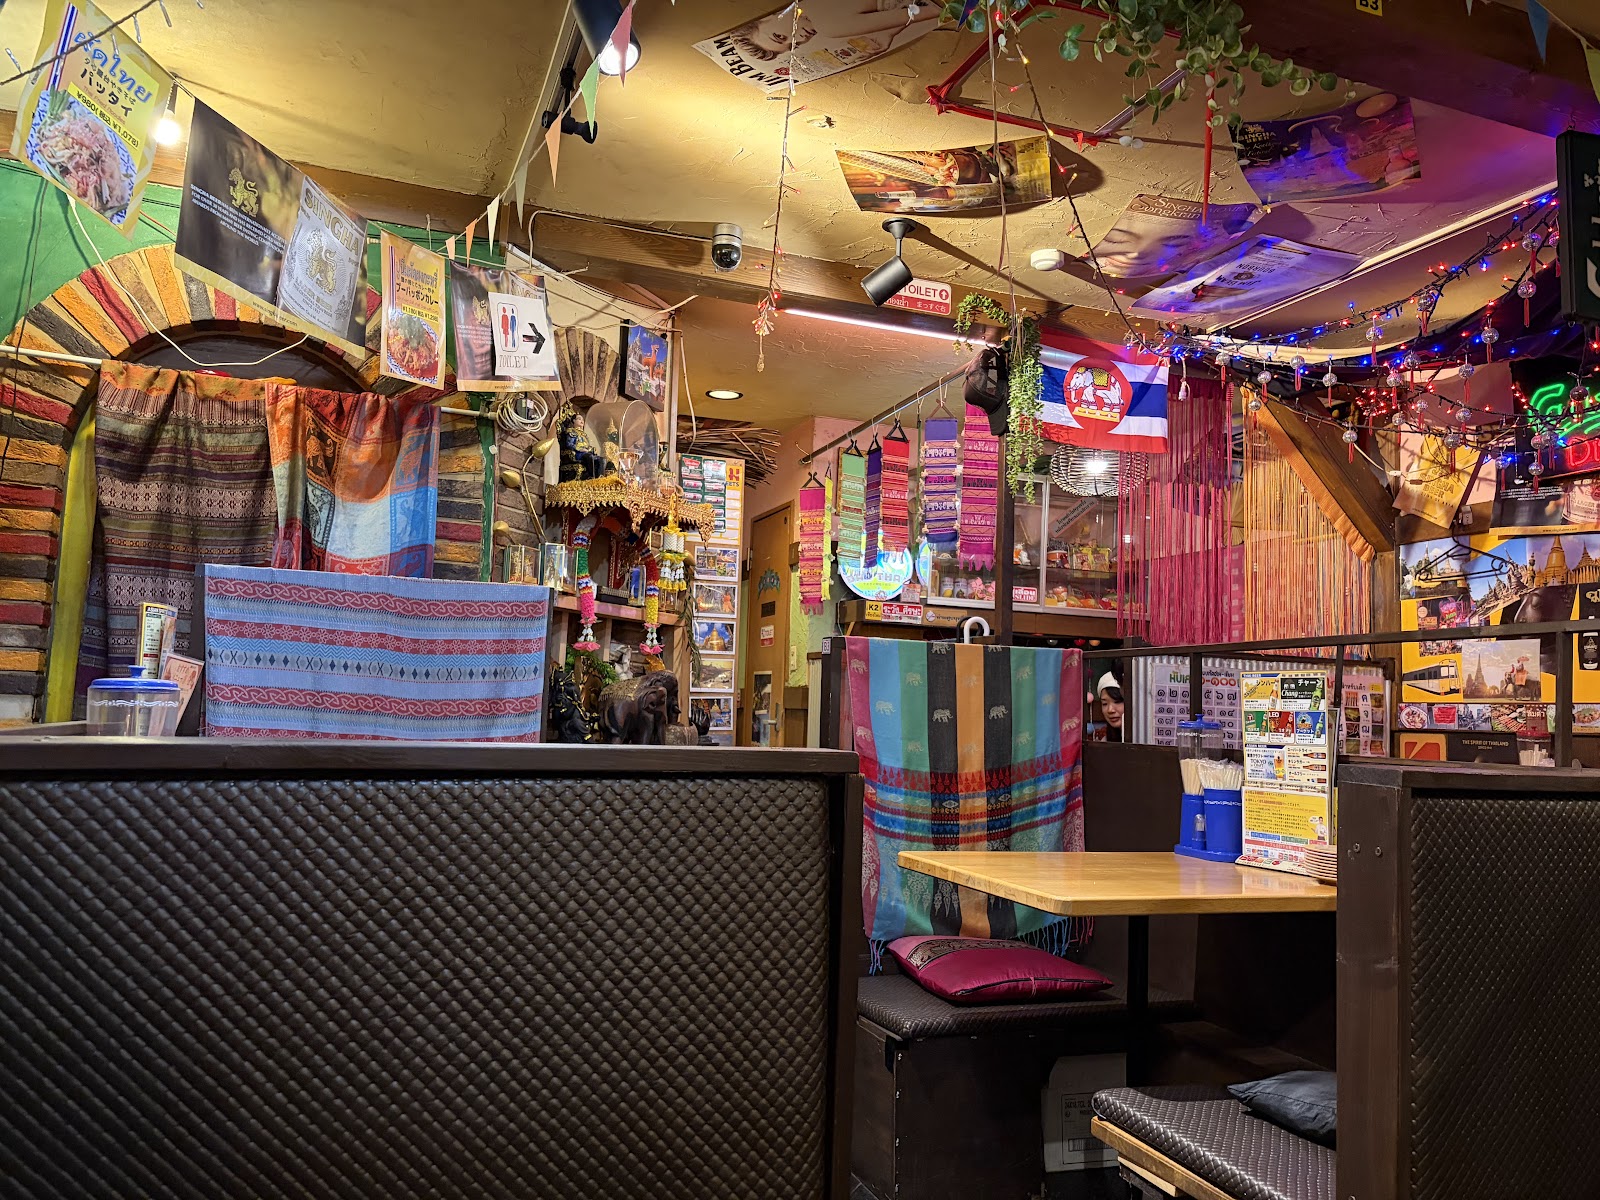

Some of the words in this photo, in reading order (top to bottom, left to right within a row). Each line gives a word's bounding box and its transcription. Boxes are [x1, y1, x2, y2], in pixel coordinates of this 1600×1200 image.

[714, 36, 754, 77] BEAM
[80, 68, 132, 118] パッタイ
[1155, 198, 1203, 214] SINGHA
[304, 187, 360, 256] SINGHA
[499, 354, 528, 368] TOILET
[1158, 689, 1165, 697] ๑
[1170, 688, 1177, 697] ๒
[1216, 691, 1224, 700] ๖
[1227, 692, 1237, 700] ๗
[1282, 690, 1298, 698] Chang
